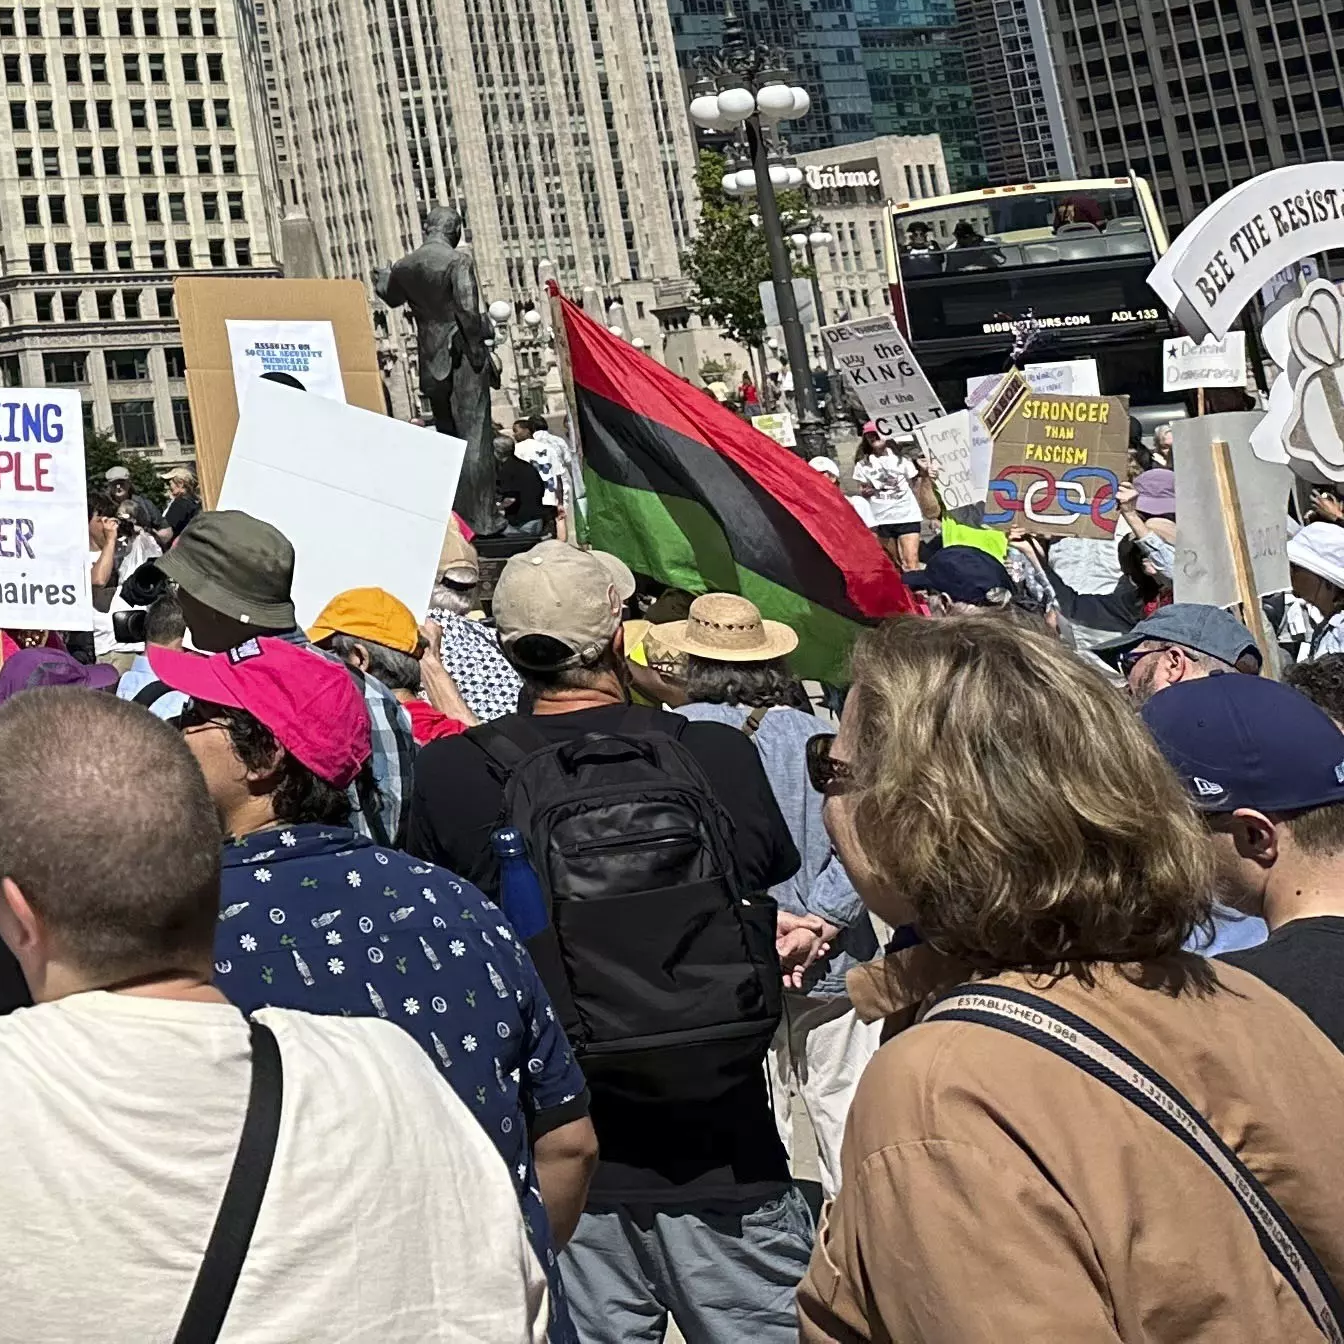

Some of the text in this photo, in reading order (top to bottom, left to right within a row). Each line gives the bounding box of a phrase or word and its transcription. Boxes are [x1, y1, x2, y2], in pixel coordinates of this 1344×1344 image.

[805, 165, 881, 190] Tribune
[1195, 250, 1236, 307] BEE
[1230, 214, 1272, 265] THE
[1269, 188, 1344, 238] RESIST
[261, 357, 310, 365] MEDICARE
[874, 343, 904, 360] the
[850, 361, 915, 385] KING
[875, 407, 943, 436] CULT
[1022, 400, 1110, 424] STRONGER
[1045, 425, 1075, 440] THAN
[1025, 443, 1088, 465] FASCISM
[957, 997, 1077, 1044] ESTABLISHED 1988
